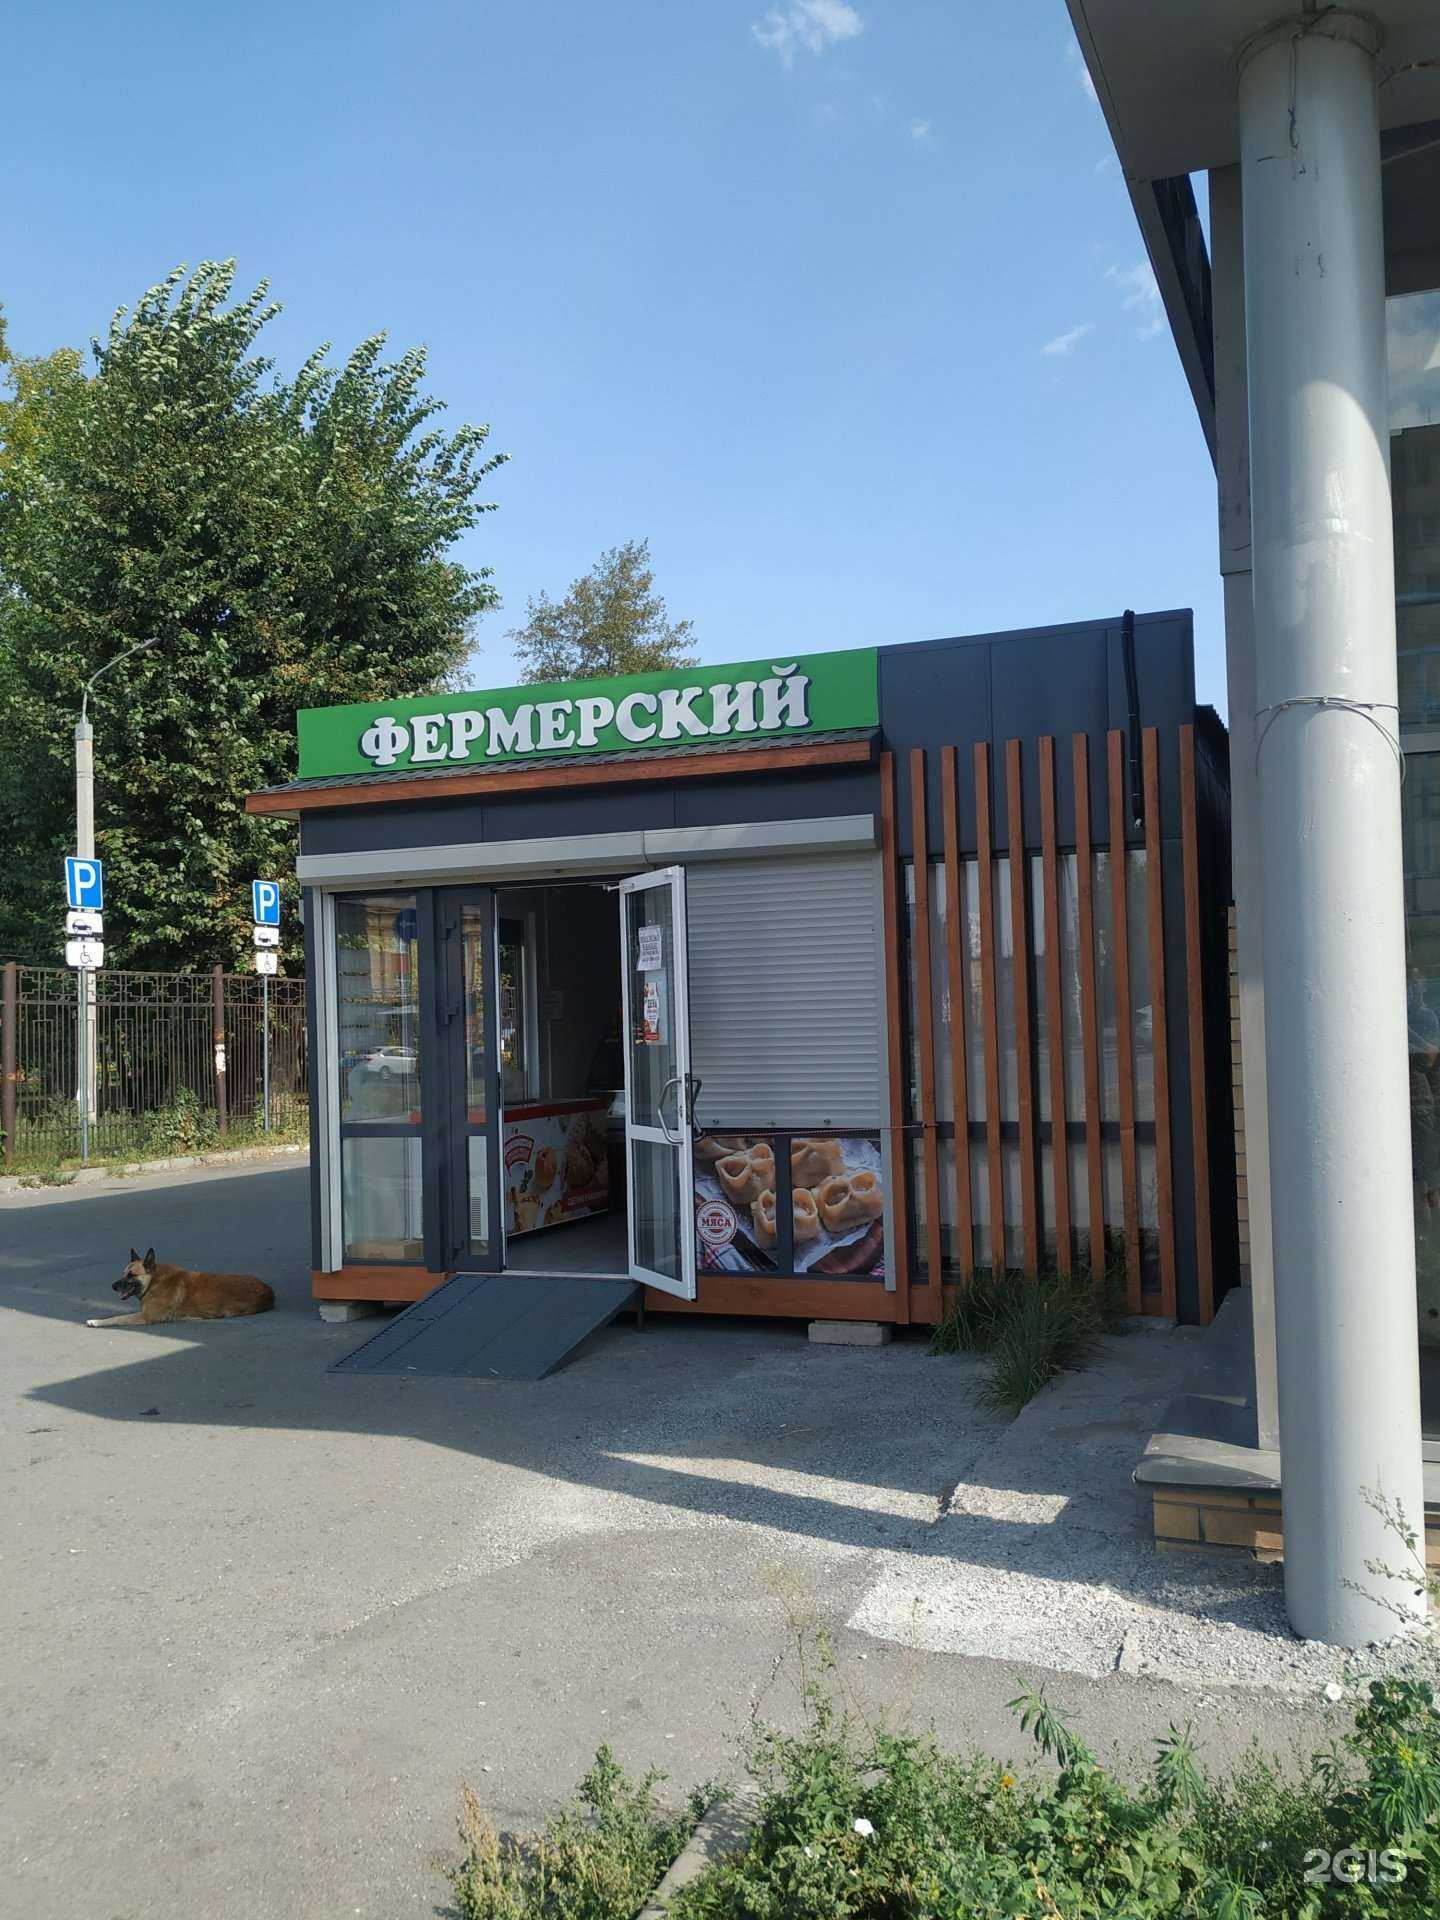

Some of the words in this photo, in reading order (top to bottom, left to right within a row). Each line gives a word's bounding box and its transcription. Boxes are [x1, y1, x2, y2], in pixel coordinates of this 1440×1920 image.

[360, 663, 811, 766] ФЕРМЕРСКИЙ
[74, 862, 96, 905] P
[259, 884, 276, 921] P
[702, 1219, 732, 1227] МЯСА
